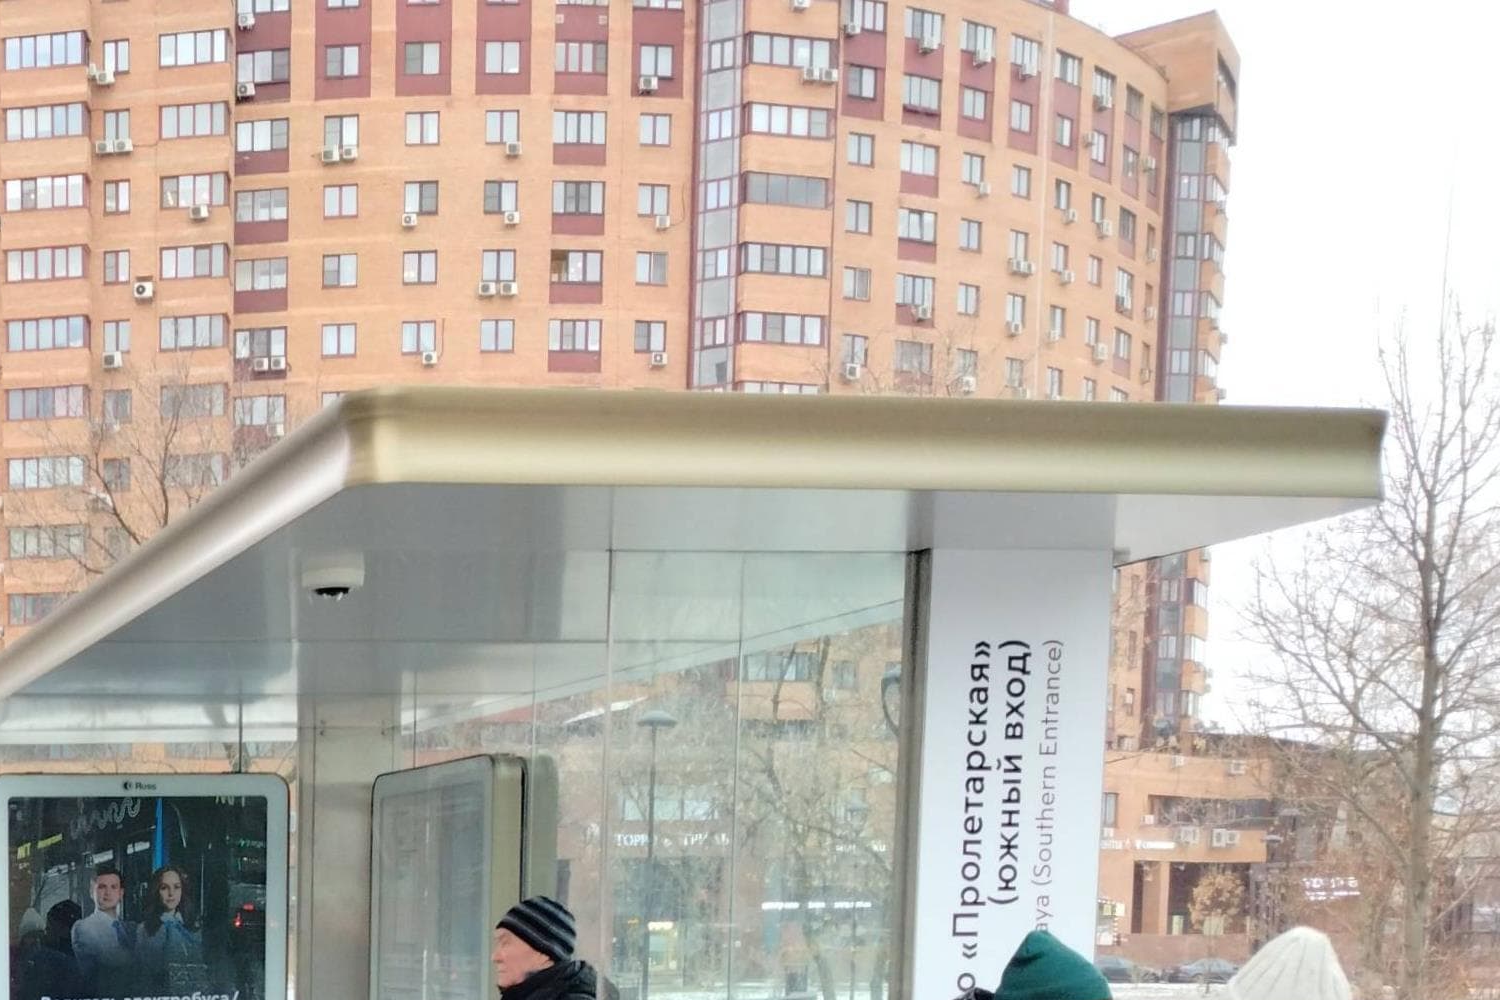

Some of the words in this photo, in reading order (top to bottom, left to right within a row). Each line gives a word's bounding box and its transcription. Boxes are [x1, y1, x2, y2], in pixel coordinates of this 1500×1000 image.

[998, 640, 1032, 740] вход)
[1039, 640, 1064, 756] Entrance)
[952, 641, 991, 959] «Пролетарская»
[988, 755, 1023, 905] (южный
[1031, 766, 1056, 886] (Southern
[1035, 895, 1053, 932] aya
